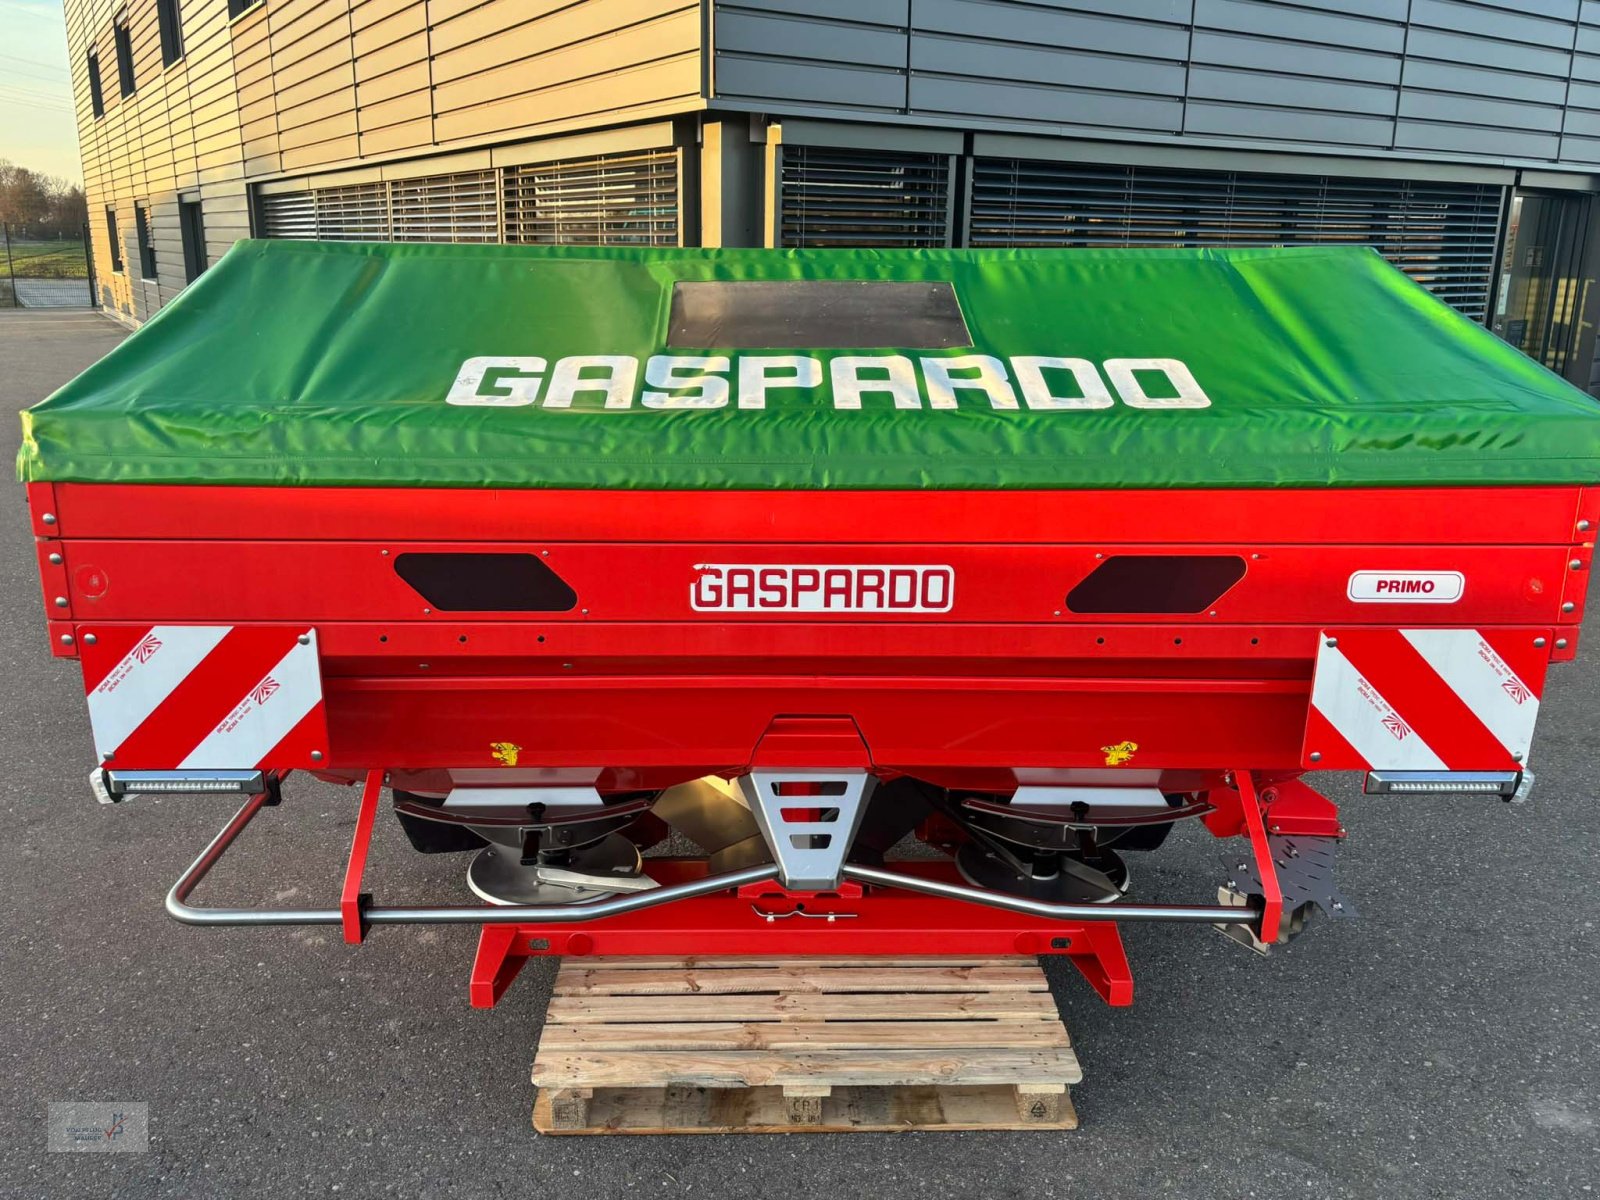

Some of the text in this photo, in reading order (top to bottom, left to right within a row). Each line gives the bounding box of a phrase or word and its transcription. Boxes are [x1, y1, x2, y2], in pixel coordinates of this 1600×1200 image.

[445, 354, 1212, 410] GASPARDO
[694, 568, 951, 609] GASPARDO
[1376, 580, 1435, 593] PRIMO
